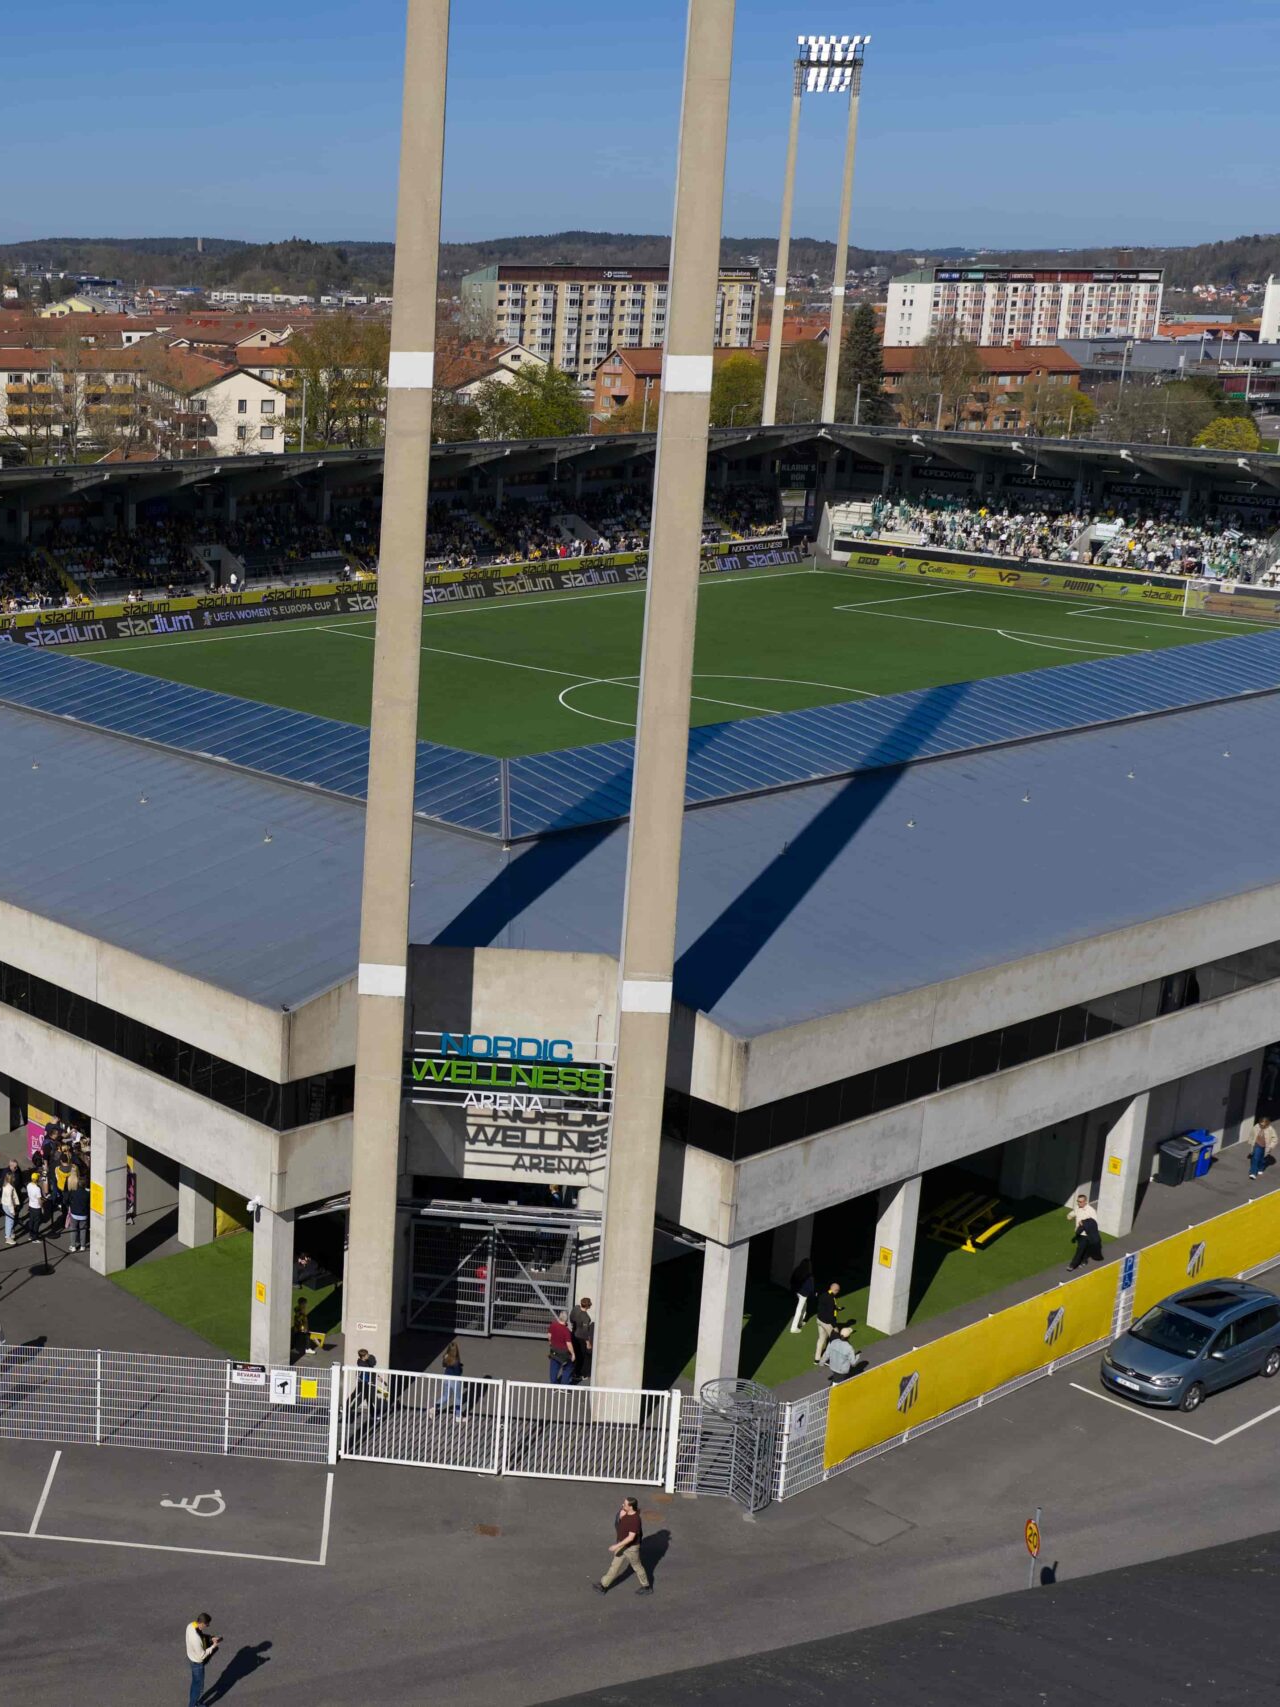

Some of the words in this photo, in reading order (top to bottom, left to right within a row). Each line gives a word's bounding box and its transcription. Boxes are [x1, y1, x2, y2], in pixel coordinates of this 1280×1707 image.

[700, 555, 741, 572] adium
[746, 550, 798, 568] stadium
[493, 575, 554, 596] stadium
[561, 568, 620, 588] stadium
[1063, 579, 1095, 592] PUMA
[423, 582, 486, 604] stadium
[1141, 589, 1186, 603] stadium
[45, 608, 95, 624] stadium
[123, 599, 170, 616] stadium
[213, 611, 236, 622] UEFA
[236, 606, 278, 620] WOMEN'S
[280, 602, 313, 614] EUROPA
[315, 601, 332, 610] CUP
[25, 622, 107, 647] stadium
[116, 612, 194, 638] stadium
[440, 1032, 573, 1063] NORDIC
[412, 1059, 605, 1092] WELLNESS
[462, 1091, 544, 1113] ARENA
[1126, 1256, 1133, 1270] P
[1028, 1526, 1037, 1549] 20
